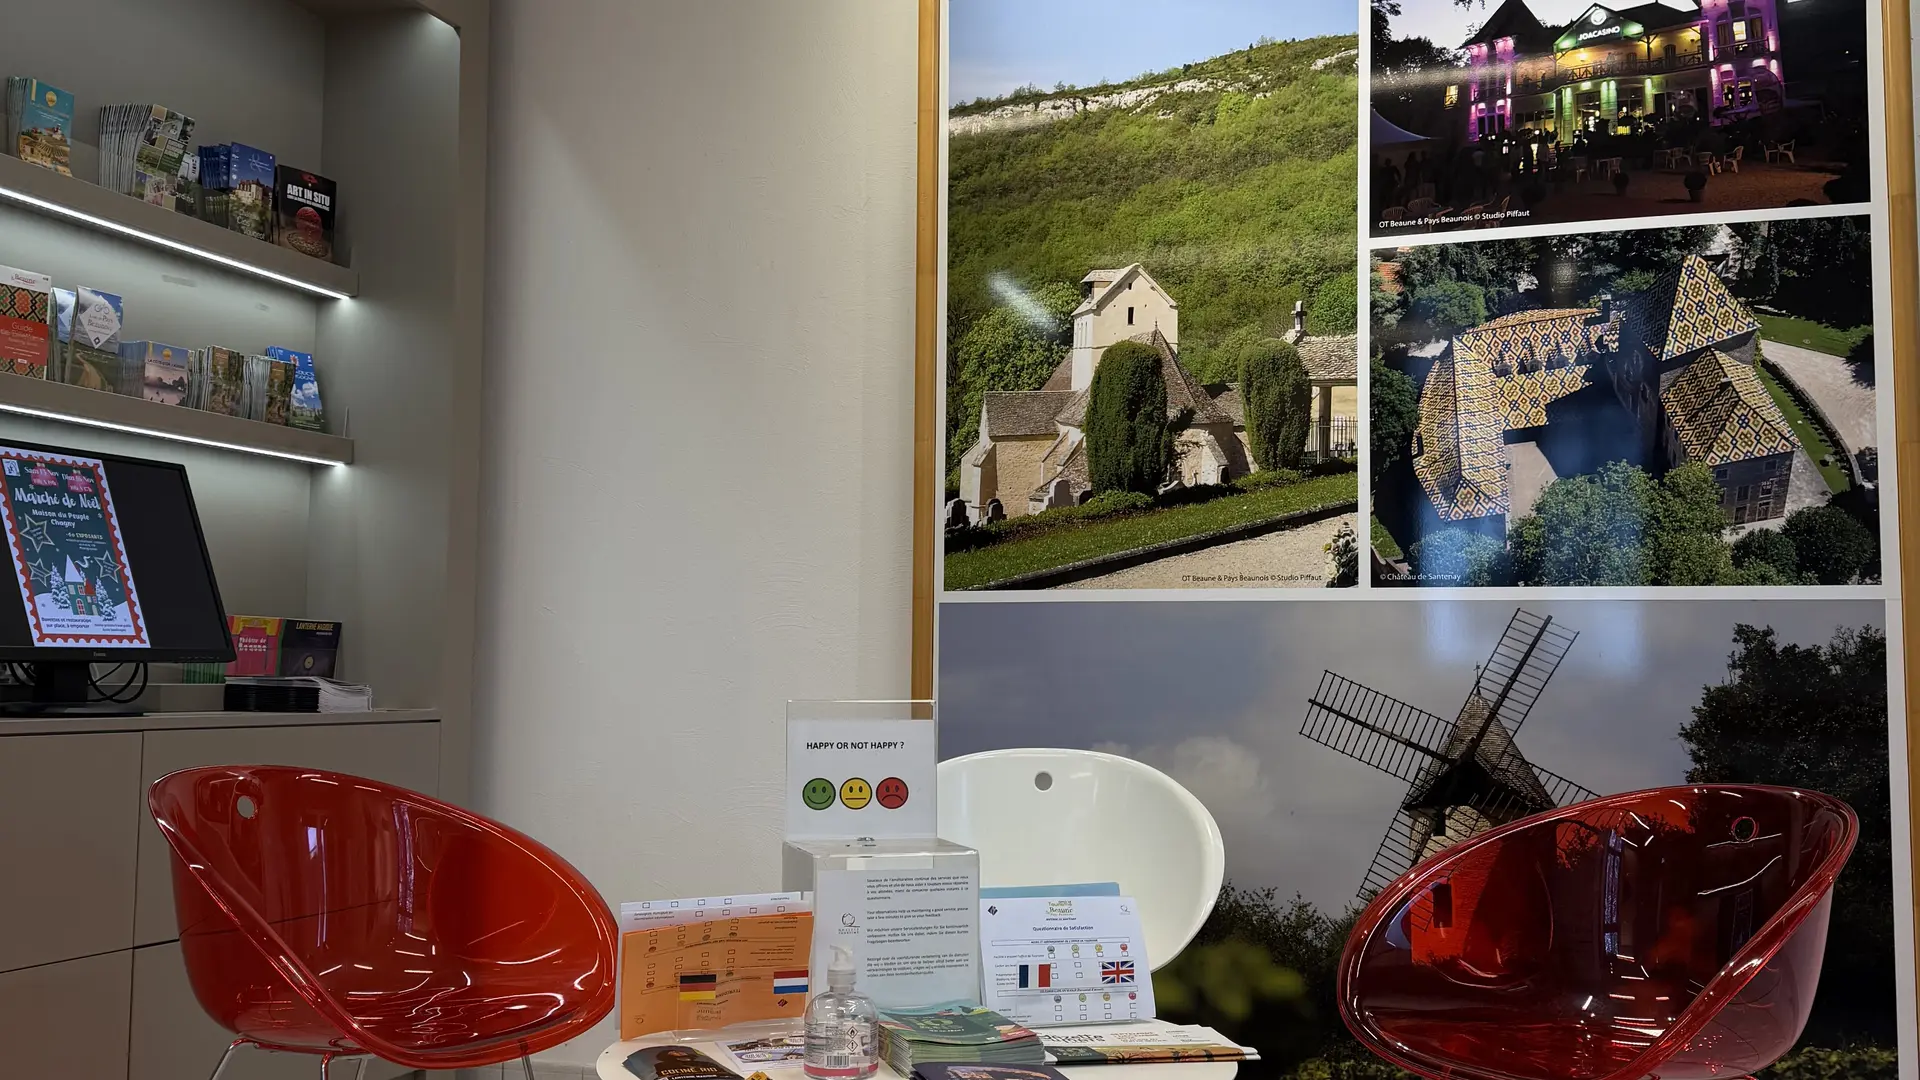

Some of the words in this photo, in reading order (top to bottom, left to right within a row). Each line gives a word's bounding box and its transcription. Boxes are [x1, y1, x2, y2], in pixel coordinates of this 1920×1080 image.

[287, 183, 303, 197] ART
[304, 187, 312, 200] IN
[313, 191, 330, 207] SITU
[1379, 220, 1389, 228] OT
[1390, 219, 1416, 228] Beaune
[1424, 217, 1440, 225] Pays
[1441, 215, 1473, 224] Beaunois
[1481, 211, 1505, 220] Studio
[1506, 209, 1530, 218] Piffaut
[14, 487, 60, 506] Marché
[62, 492, 76, 509] de
[79, 493, 101, 510] Noël
[32, 509, 57, 518] Maison
[57, 511, 67, 519] du
[68, 512, 90, 521] Peuple
[50, 519, 76, 529] Chagny
[1192, 574, 1216, 582] Beaune
[1217, 574, 1223, 582] &
[1223, 574, 1238, 583] Pays
[1277, 573, 1299, 581] Studio
[1300, 573, 1322, 581] Piffaut
[1387, 572, 1416, 580] Château
[1428, 573, 1461, 582] Santenay
[295, 622, 317, 630] LANTERNE
[806, 741, 835, 750] HAPPY
[836, 741, 849, 750] OR
[850, 741, 869, 750] NOT
[870, 741, 898, 749] HAPPY
[900, 741, 905, 749] ?
